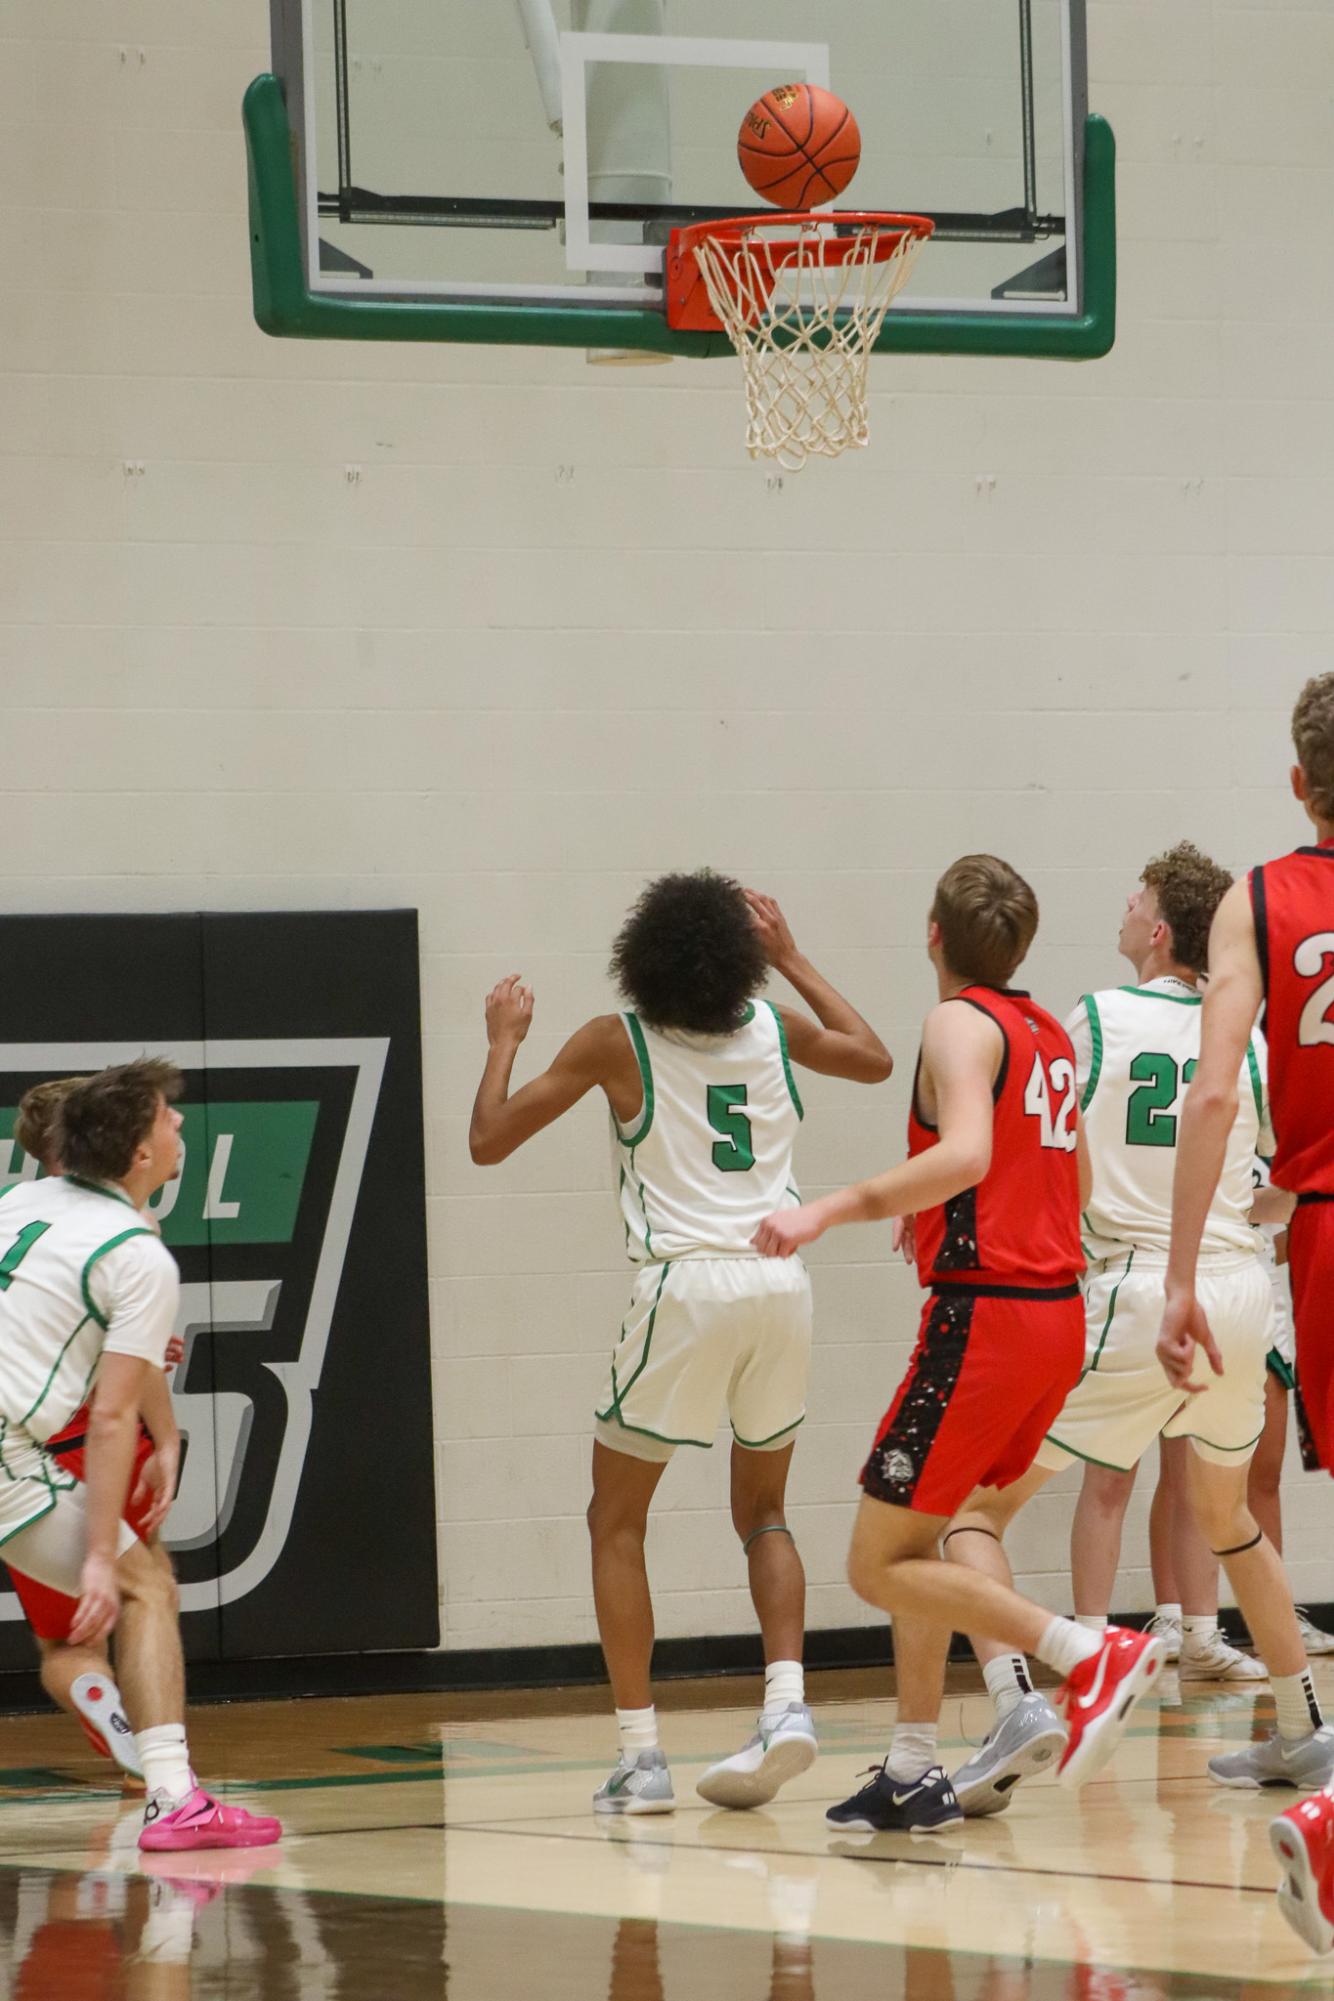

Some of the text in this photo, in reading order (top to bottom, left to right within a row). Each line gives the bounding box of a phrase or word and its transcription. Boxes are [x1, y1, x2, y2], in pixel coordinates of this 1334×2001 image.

[706, 1083, 756, 1172] 5
[1024, 1051, 1078, 1153] 42
[1126, 1052, 1200, 1147] 2
